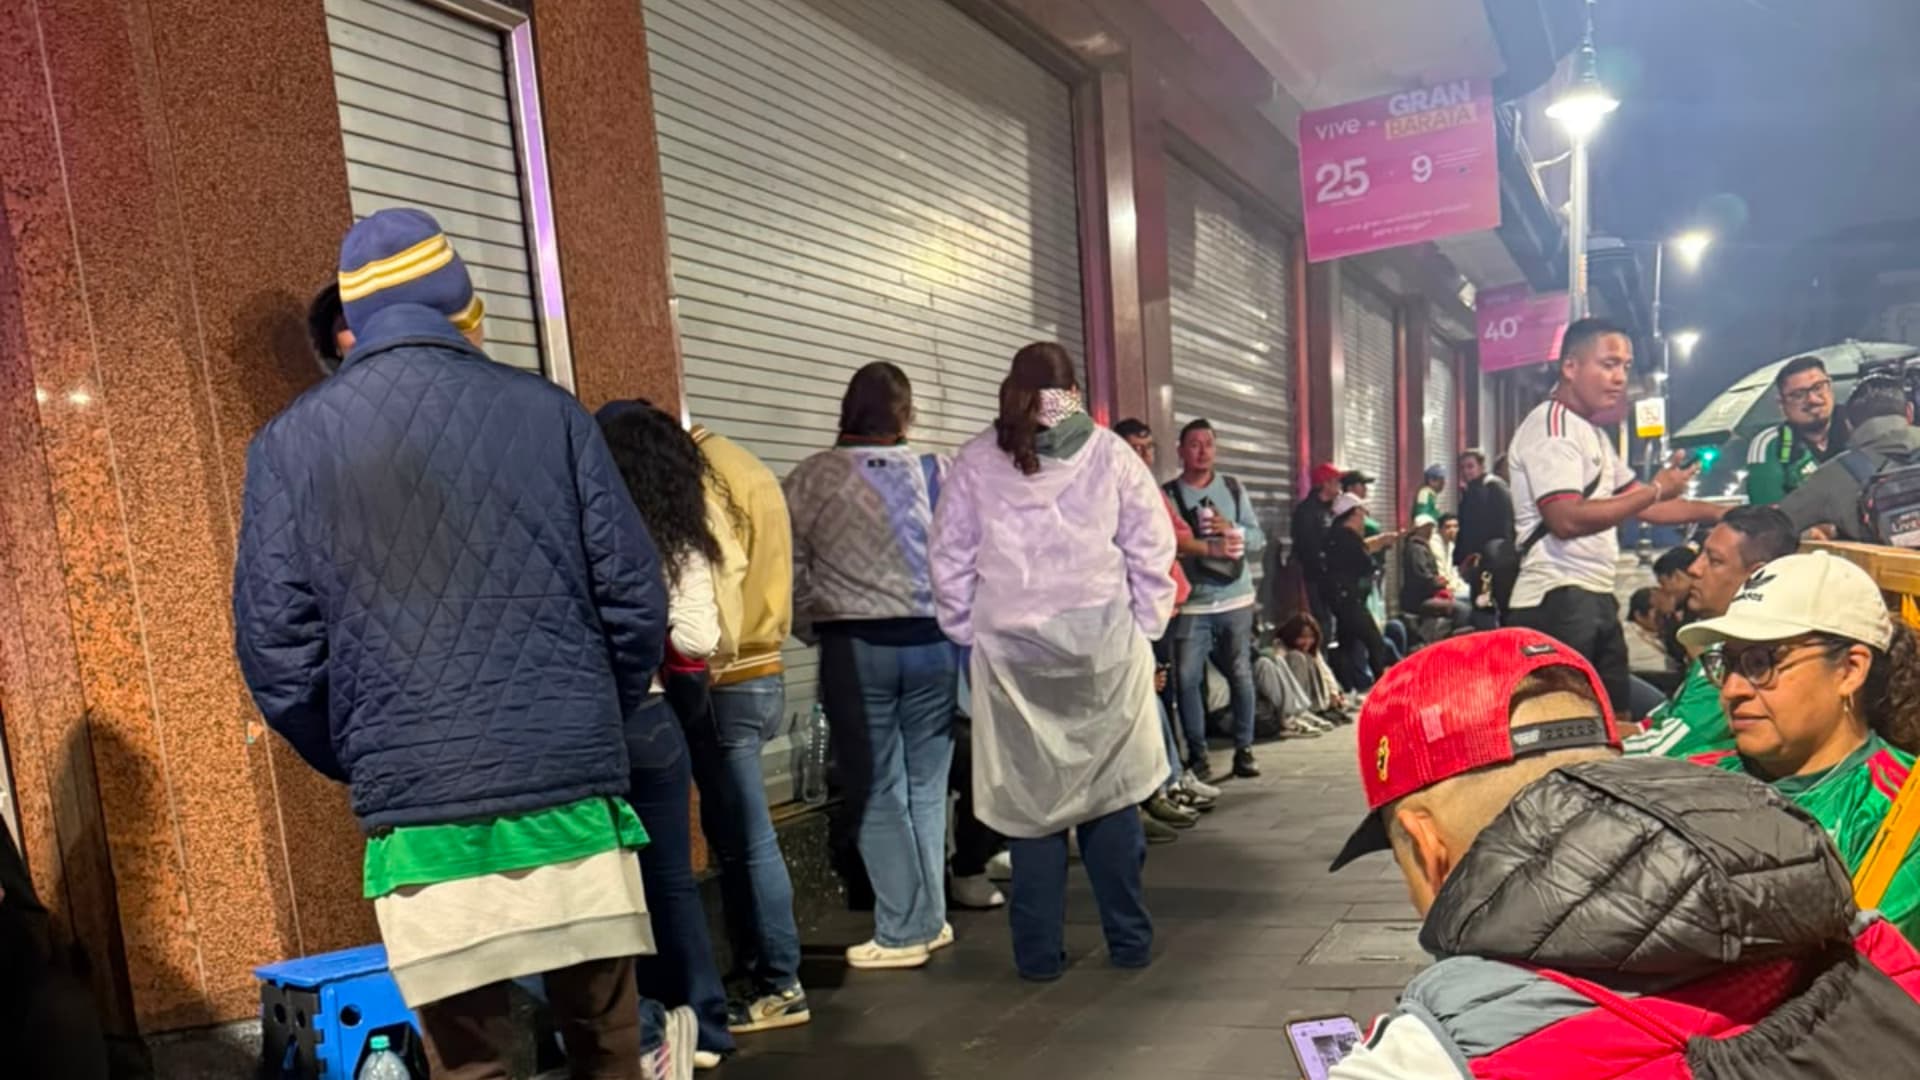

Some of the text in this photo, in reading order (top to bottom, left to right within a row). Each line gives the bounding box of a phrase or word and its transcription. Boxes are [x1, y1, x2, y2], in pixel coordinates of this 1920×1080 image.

[1388, 81, 1471, 116] GRAN
[1390, 107, 1473, 136] BARATA
[1315, 157, 1370, 203] 25
[1411, 155, 1433, 183] 9
[1484, 317, 1518, 341] 40
